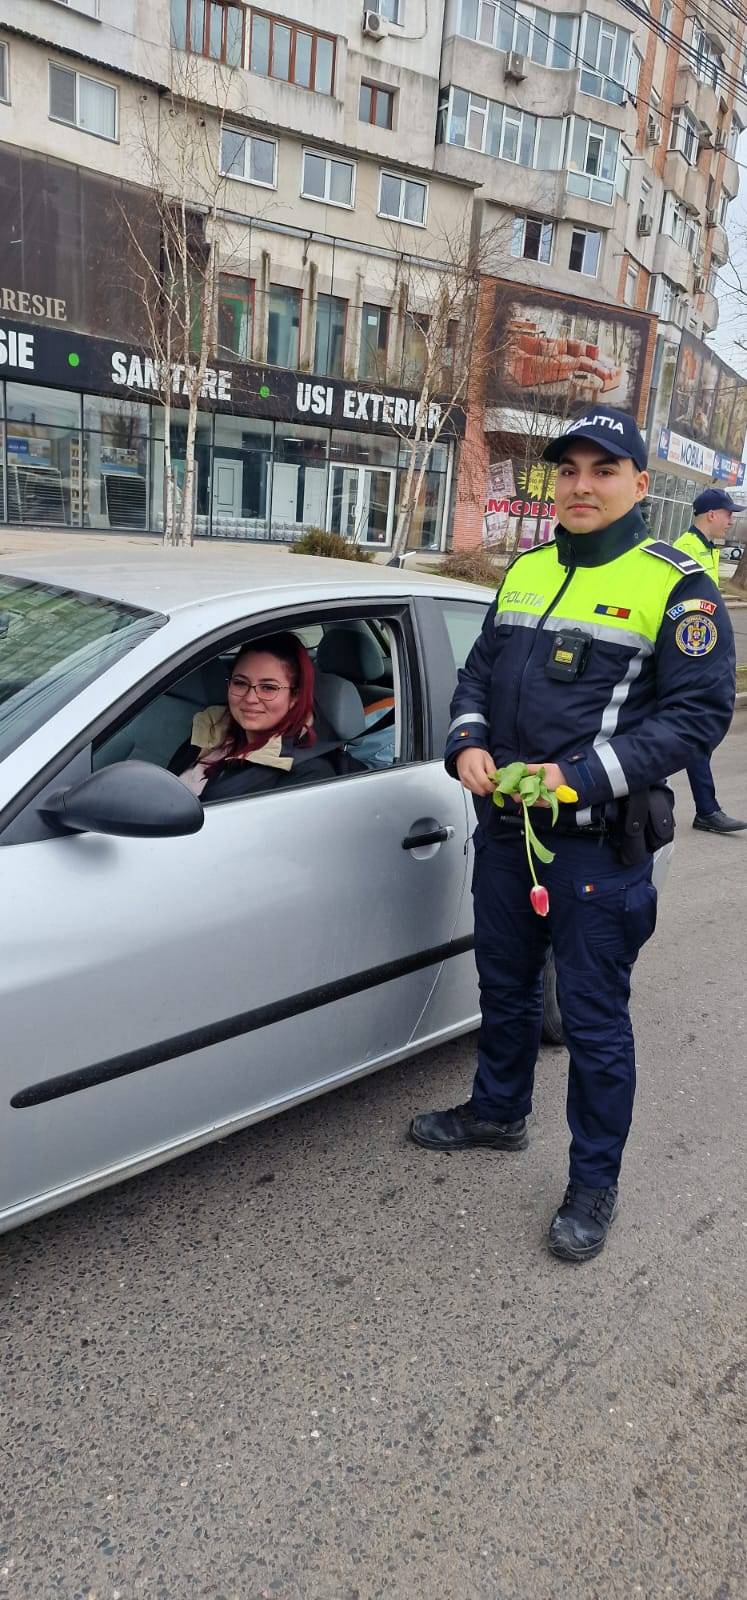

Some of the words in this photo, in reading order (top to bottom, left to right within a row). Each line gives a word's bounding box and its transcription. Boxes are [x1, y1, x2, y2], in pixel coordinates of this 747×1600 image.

[0, 287, 67, 321] RESIE
[297, 382, 333, 416] USI
[566, 415, 624, 435] POLITIA
[502, 591, 545, 607] POLITIA
[669, 600, 713, 617] RONIA
